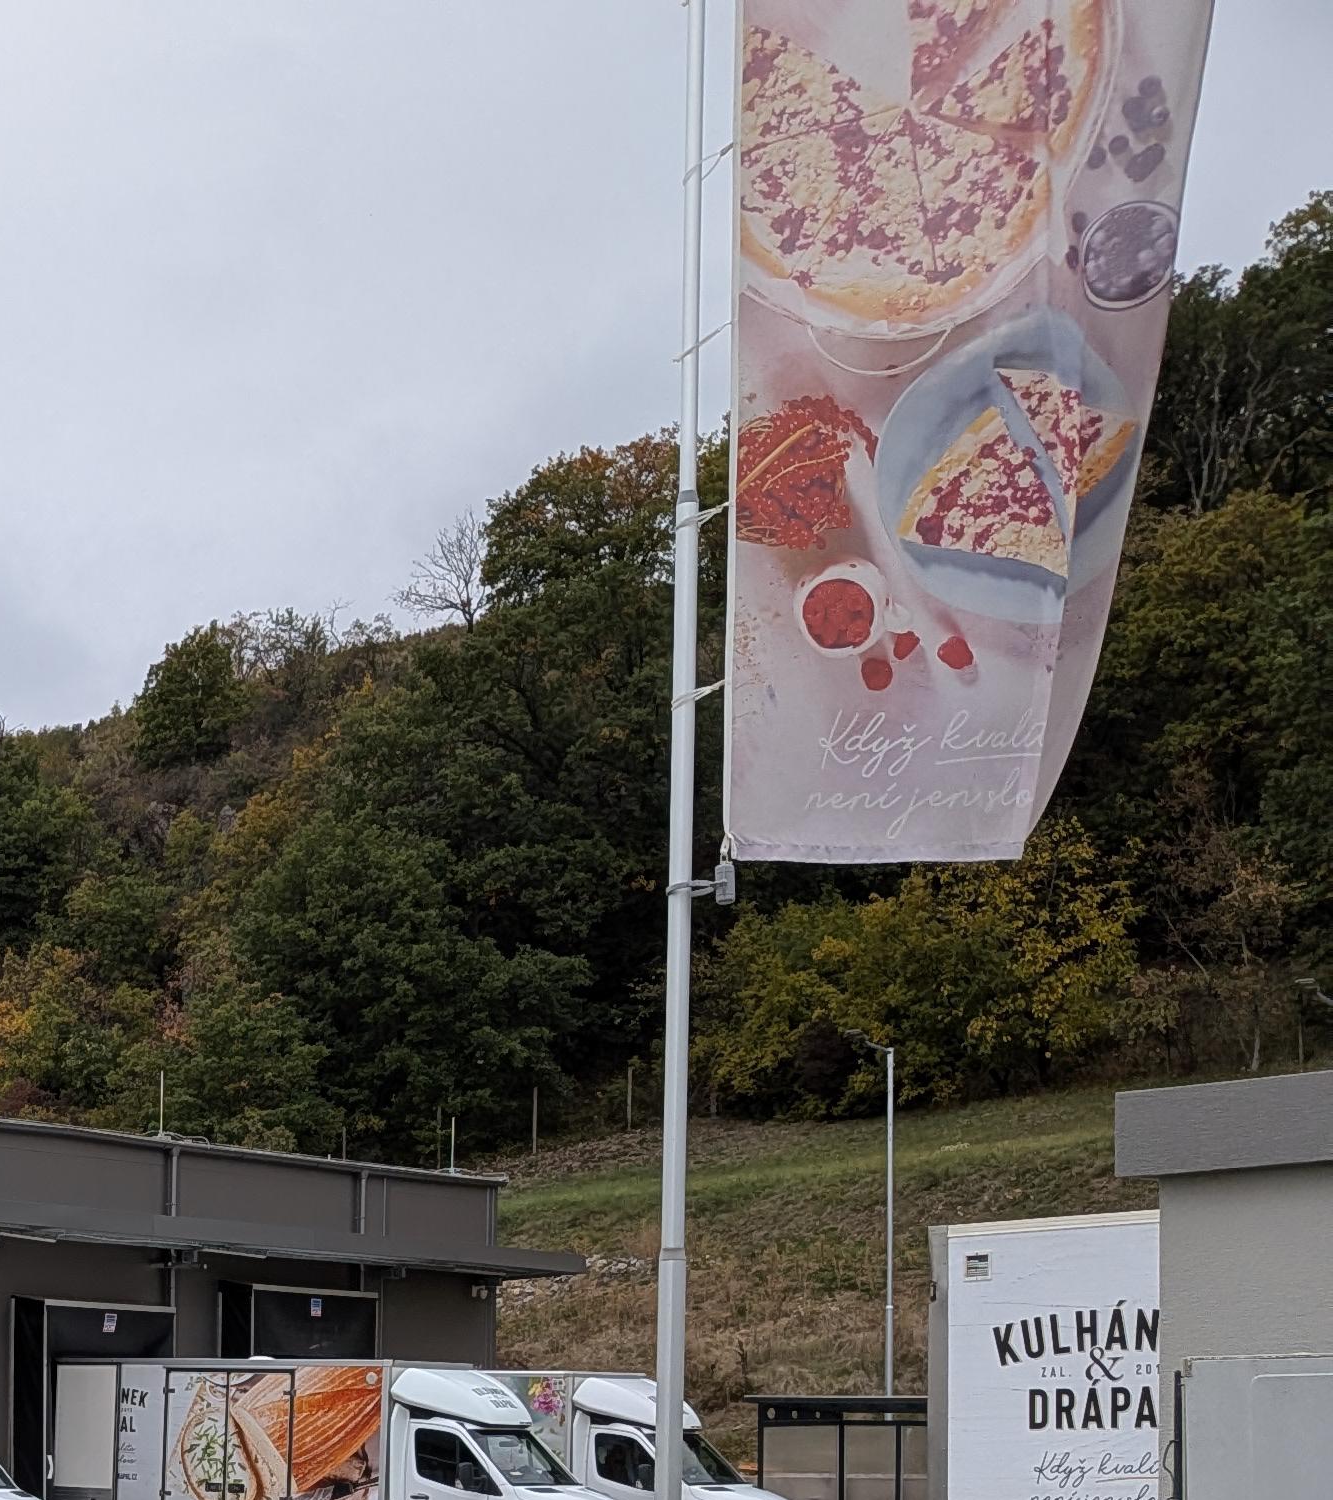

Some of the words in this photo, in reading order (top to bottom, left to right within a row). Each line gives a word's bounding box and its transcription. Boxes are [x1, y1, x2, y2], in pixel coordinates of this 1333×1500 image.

[819, 710, 933, 778] Když
[805, 782, 902, 810] není
[886, 788, 983, 840] jen
[1041, 1366, 1072, 1378] ZAL.
[1085, 1346, 1125, 1381] &
[1029, 1379, 1158, 1430] DRÁPA
[1034, 1450, 1093, 1488] Když
